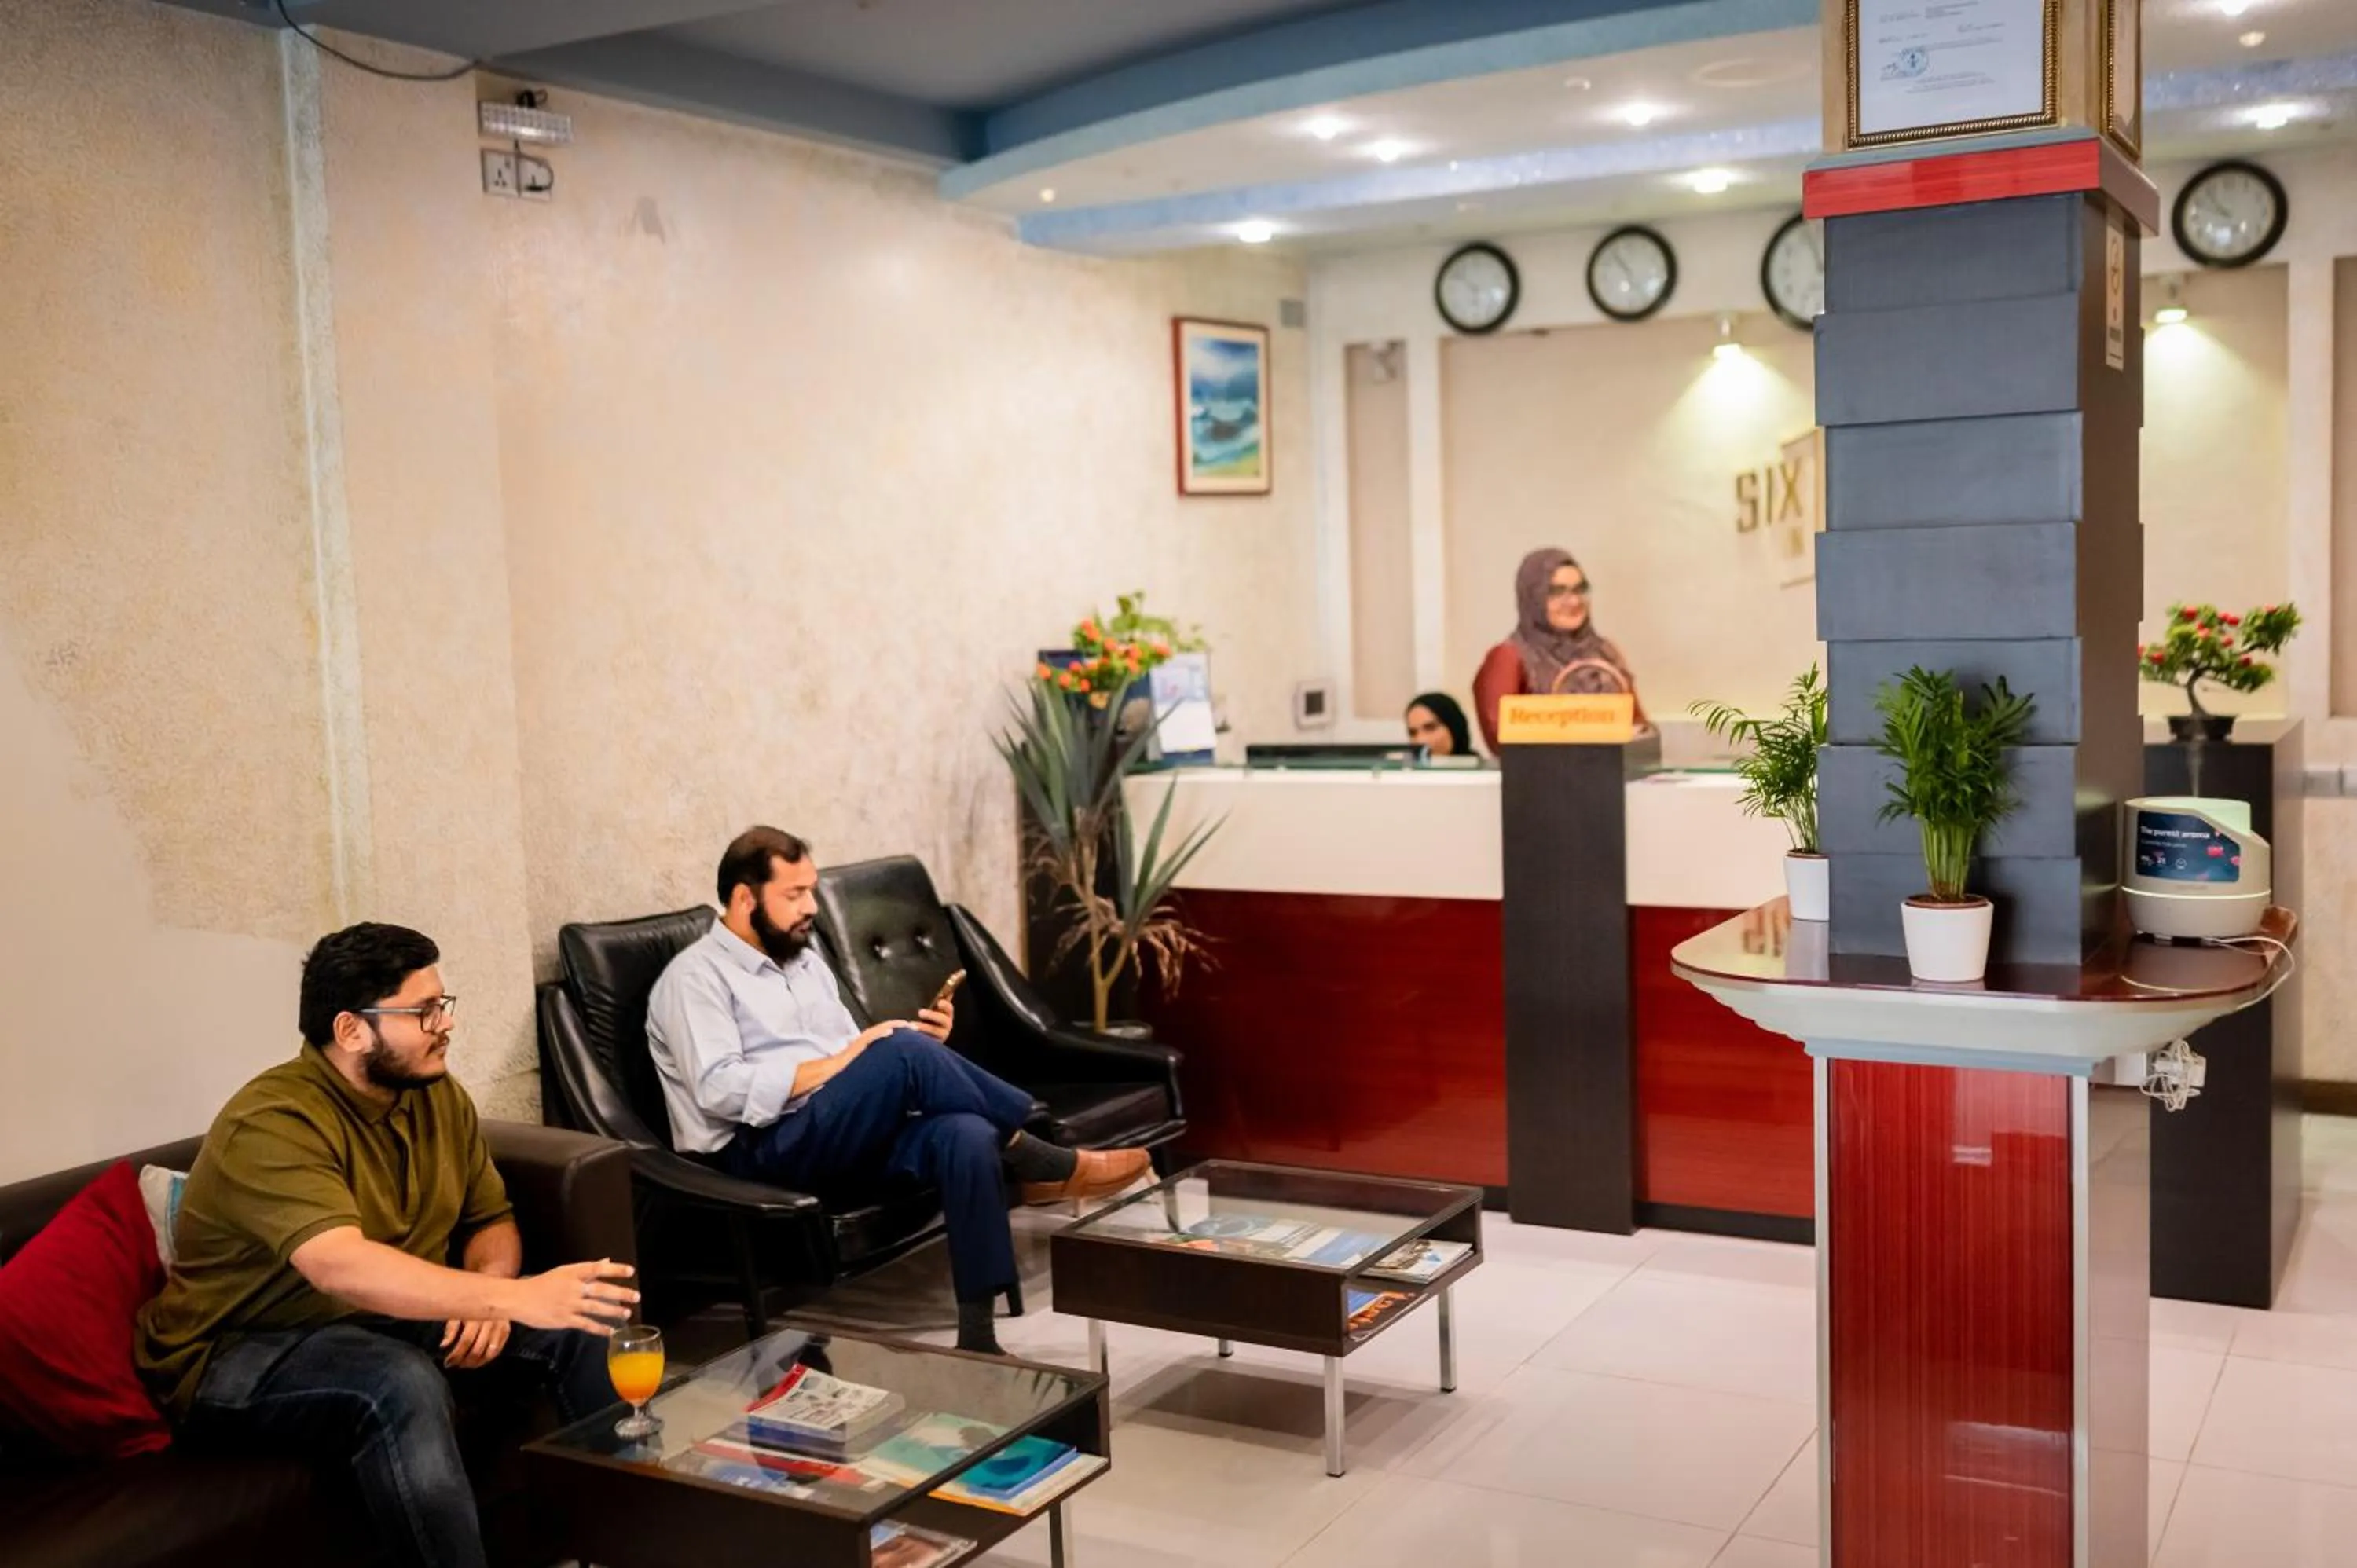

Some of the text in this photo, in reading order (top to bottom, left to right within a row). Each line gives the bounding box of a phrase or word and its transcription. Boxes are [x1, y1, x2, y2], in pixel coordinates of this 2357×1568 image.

[1735, 457, 1802, 534] SIX
[1508, 705, 1615, 728] Reception
[2140, 826, 2153, 834] The
